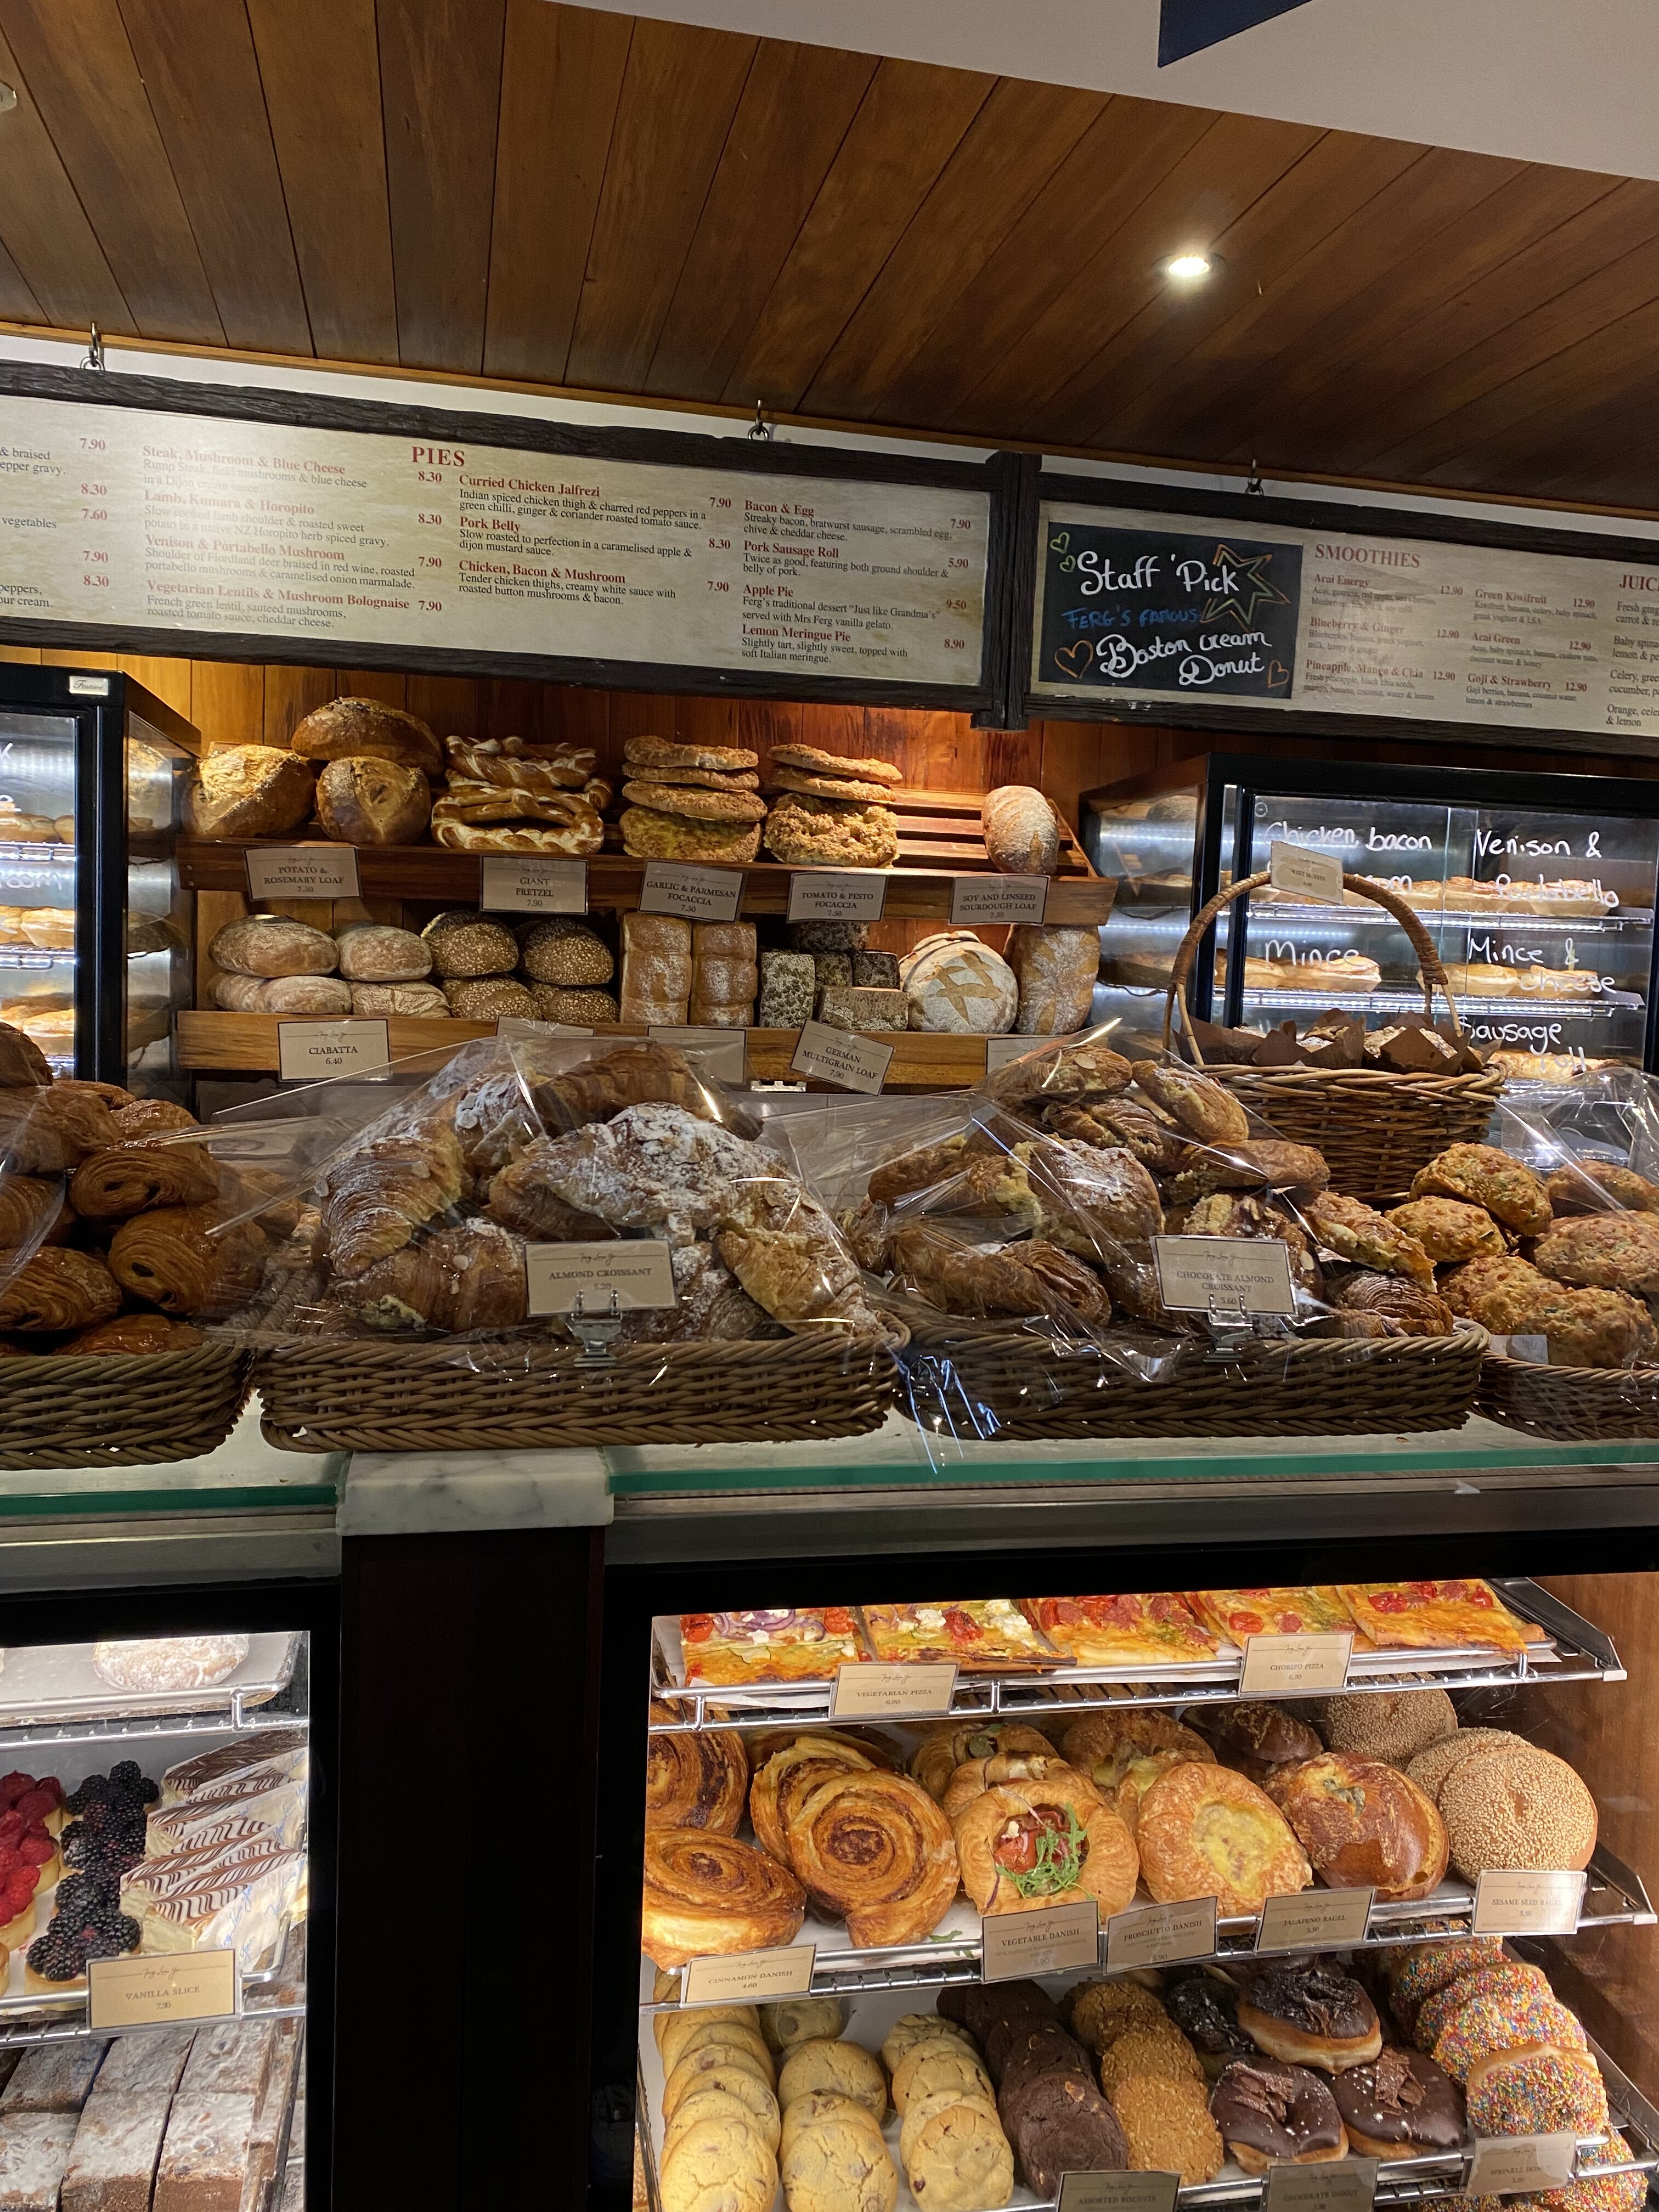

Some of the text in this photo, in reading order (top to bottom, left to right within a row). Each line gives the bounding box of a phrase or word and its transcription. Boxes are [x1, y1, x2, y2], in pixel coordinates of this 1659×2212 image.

[80, 438, 105, 450] 7.90
[411, 446, 465, 467] PIES
[418, 471, 442, 483] 8.30
[81, 483, 106, 495] 8.30
[459, 475, 600, 495] Curried Chicken Jalfrezi
[460, 490, 489, 501] Indian
[492, 493, 522, 506] spiced
[523, 496, 560, 507] chicken
[562, 499, 586, 511] thigh
[588, 502, 597, 510] &
[599, 503, 634, 513] charred
[636, 506, 651, 515] red
[652, 509, 687, 520] peppers
[690, 510, 698, 519] in
[709, 496, 731, 509] 7.90
[81, 509, 107, 520] 7.60
[744, 501, 814, 517] Bacon & Egg
[2, 516, 57, 528] vegetables
[418, 514, 442, 526] 8.30
[460, 517, 521, 533] Pork Belly
[950, 519, 971, 530] 7.90
[146, 535, 345, 558] Venison & Portabello Mushroom
[709, 538, 731, 550] 8.30
[744, 541, 839, 557] Pork Sausage Roll
[83, 551, 108, 562] 7.90
[1316, 543, 1420, 568] SMOOTHIES
[418, 556, 442, 568] 7.90
[948, 557, 969, 569] 5.90
[459, 561, 625, 582] Chicken, Bacon & Mushroom
[1077, 551, 1160, 595] Staff
[83, 575, 109, 587] 8.30
[708, 580, 729, 592] 7.90
[148, 581, 410, 610] Vegetarian Lentils & Mushroom Bolognaise
[743, 585, 794, 597] Apple Pie
[418, 600, 442, 612] 7.90
[946, 599, 967, 610] 9.50
[1573, 597, 1595, 609] 12.90
[742, 625, 851, 641] Lemon Meringue Pie
[944, 639, 964, 650] 8.90
[1096, 633, 1192, 679] Boston
[1178, 652, 1265, 686] Donut
[1391, 668, 1399, 676] &
[1433, 670, 1455, 681] 12.90
[1468, 673, 1551, 691] Goji & Strawberry
[1565, 681, 1588, 692] 12.90
[1365, 826, 1432, 851] bacon
[1477, 828, 1602, 858] Venison &
[278, 866, 317, 874] POTATO
[263, 876, 316, 884] ROSEMARY
[520, 877, 550, 885] GIANT
[516, 888, 554, 896] PRETZEL
[646, 881, 679, 891] GARLIC
[690, 886, 736, 898] PARMESAN
[668, 893, 712, 905] FOCACCIA
[680, 904, 696, 913] 7.50
[1265, 939, 1360, 967] Mince
[1468, 936, 1579, 966] Mince &
[1457, 1015, 1562, 1056] Sausage
[308, 1046, 358, 1054] CIABATTA
[826, 1046, 861, 1063] GERMAN
[802, 1050, 878, 1079] MULTIGRAIN LOAF
[830, 1069, 844, 1079] 7.90
[549, 1268, 652, 1280] ALMOND CROISSANT
[1176, 1271, 1274, 1284] CHOCOLATE ALMOND
[1201, 1283, 1252, 1293] CROISSANT
[1124, 1926, 1171, 1941] PROSCIUTTO
[1172, 1920, 1203, 1931] DANISH
[1002, 1928, 1080, 1946] VEGETABLE DANISH
[1034, 1958, 1050, 1966] 5.90
[709, 1974, 758, 1984] CINNAMON
[126, 1986, 200, 2000] VANILLA SLICE
